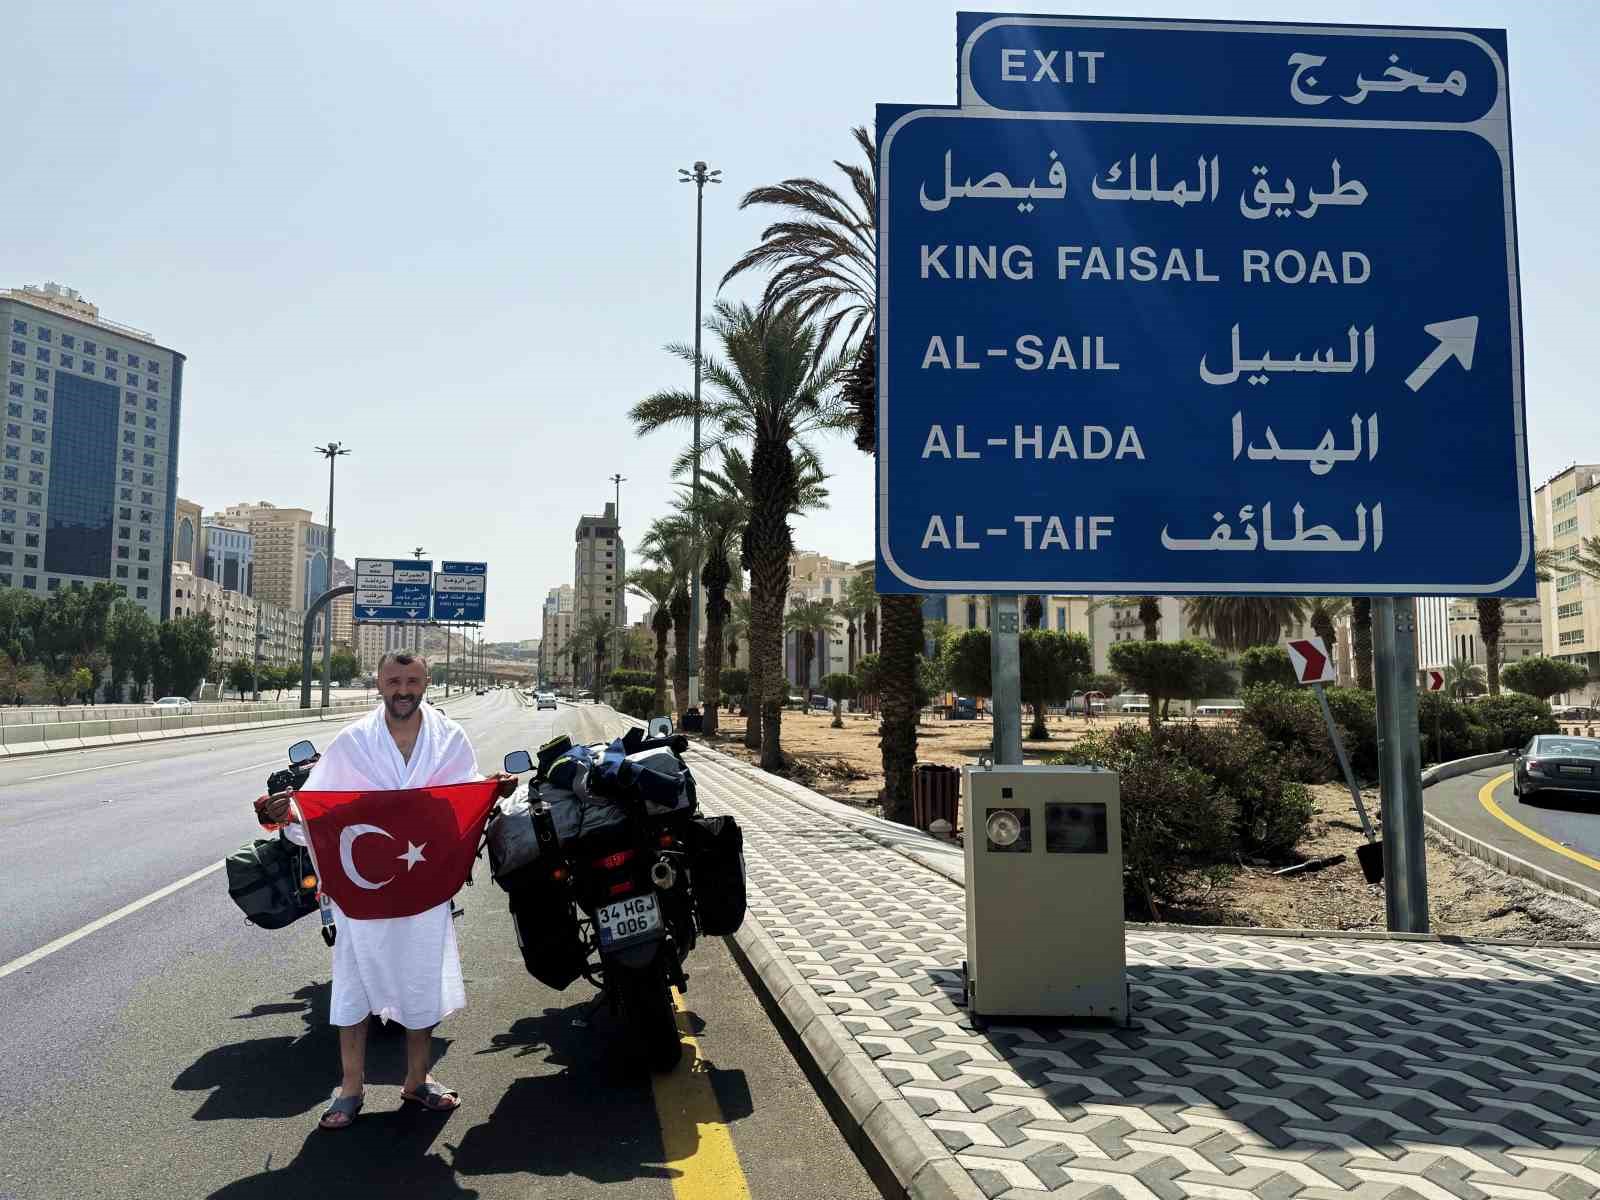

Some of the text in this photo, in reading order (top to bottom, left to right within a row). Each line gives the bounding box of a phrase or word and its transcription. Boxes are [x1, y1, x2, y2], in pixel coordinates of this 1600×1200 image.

[1001, 48, 1105, 84] EXIT
[1287, 52, 1467, 105] مخرج
[919, 150, 1369, 220] طريق الملك فيصل
[920, 244, 1371, 284] KING FAISAL ROAD
[921, 334, 1120, 370] AL-SAIL
[1199, 323, 1375, 387] السيل
[921, 424, 1146, 460] AL-HADA
[1231, 411, 1379, 476] الهدا
[921, 514, 1115, 551] AL-TAIF
[1161, 501, 1384, 553] الطائف
[600, 895, 656, 924] 34 HGJ
[616, 915, 648, 936] 006
